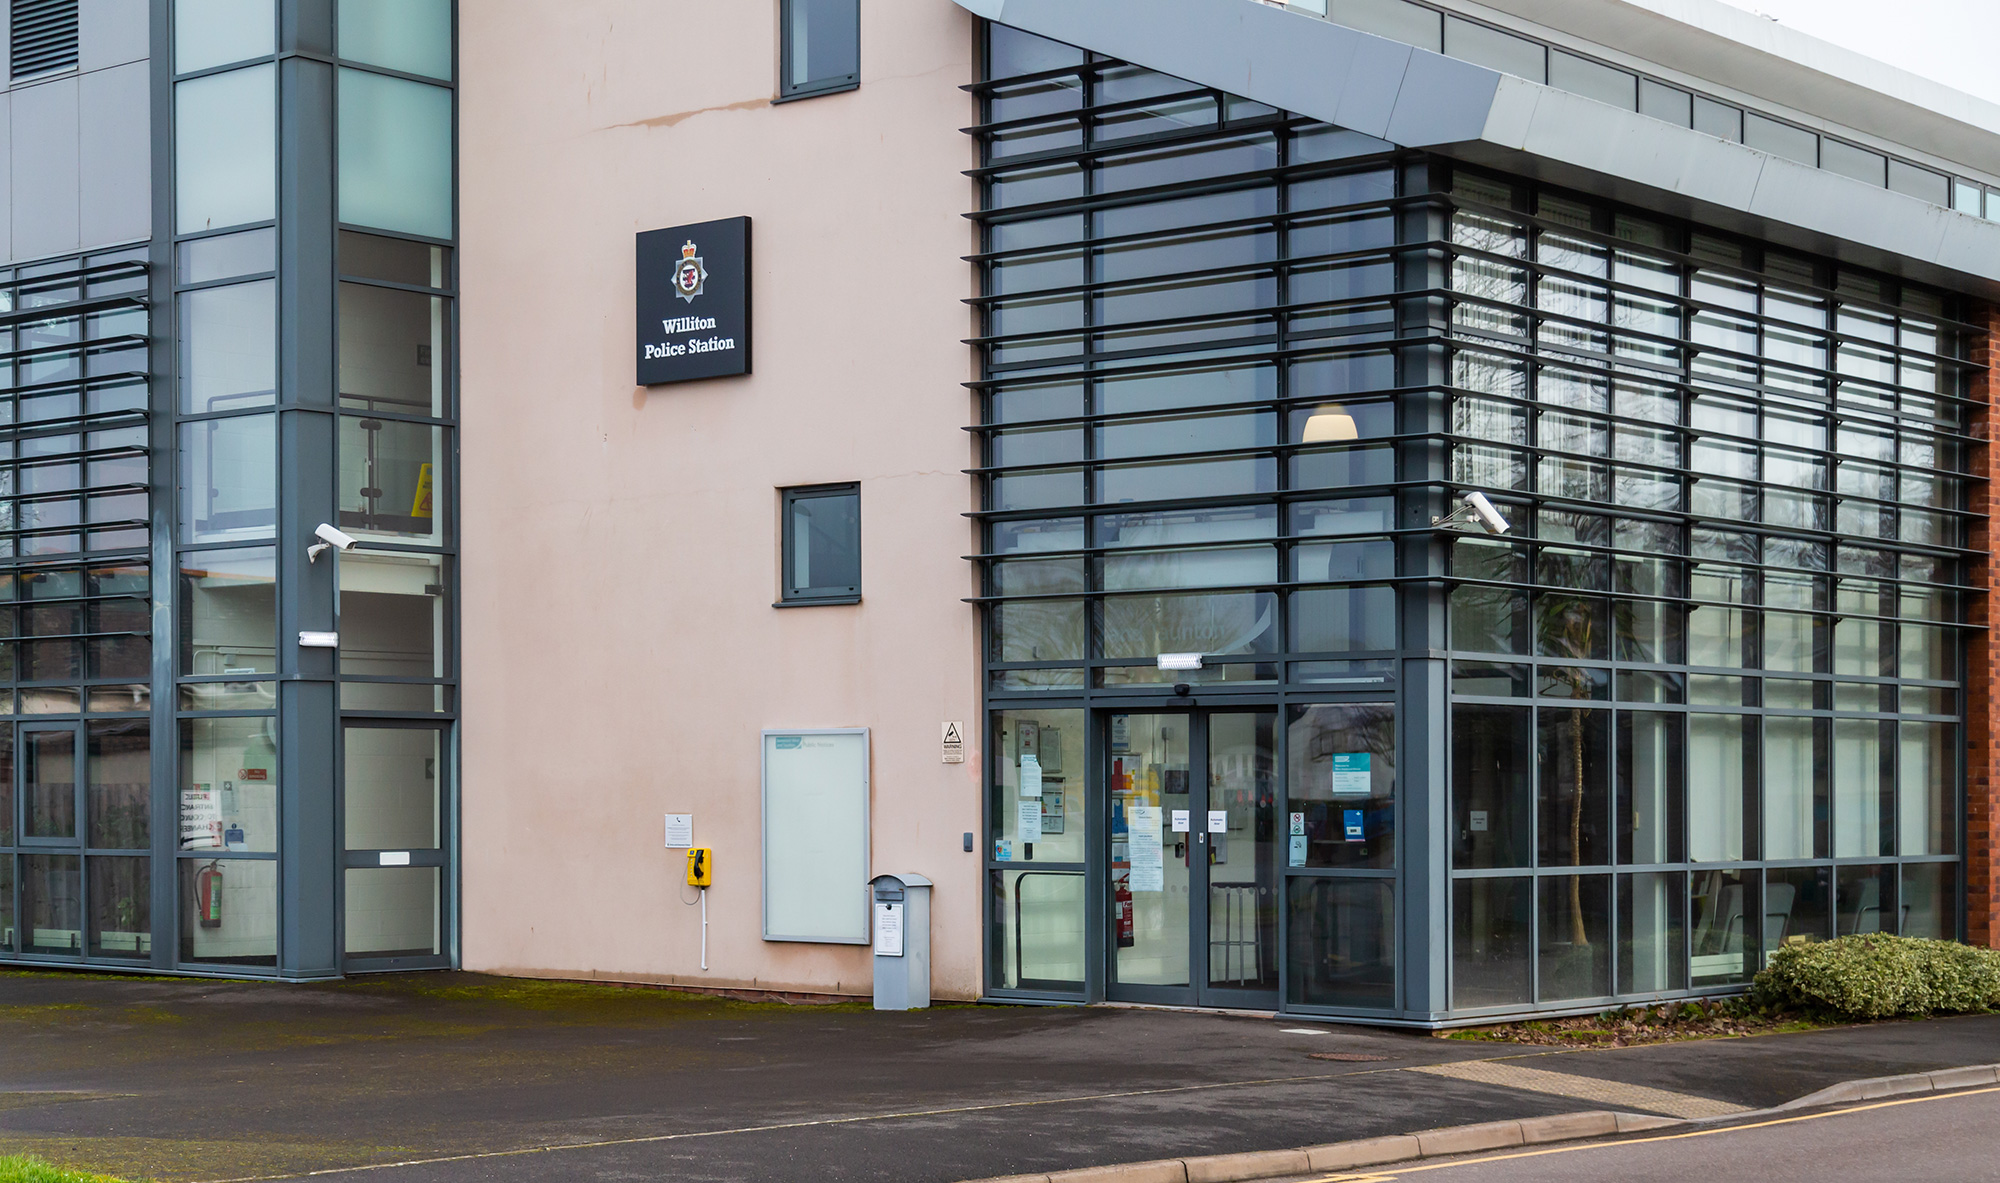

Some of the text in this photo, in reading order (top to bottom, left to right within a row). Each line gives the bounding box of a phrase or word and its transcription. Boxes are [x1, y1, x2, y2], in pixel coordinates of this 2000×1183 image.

[662, 316, 716, 334] Williton
[644, 336, 735, 360] Police Station
